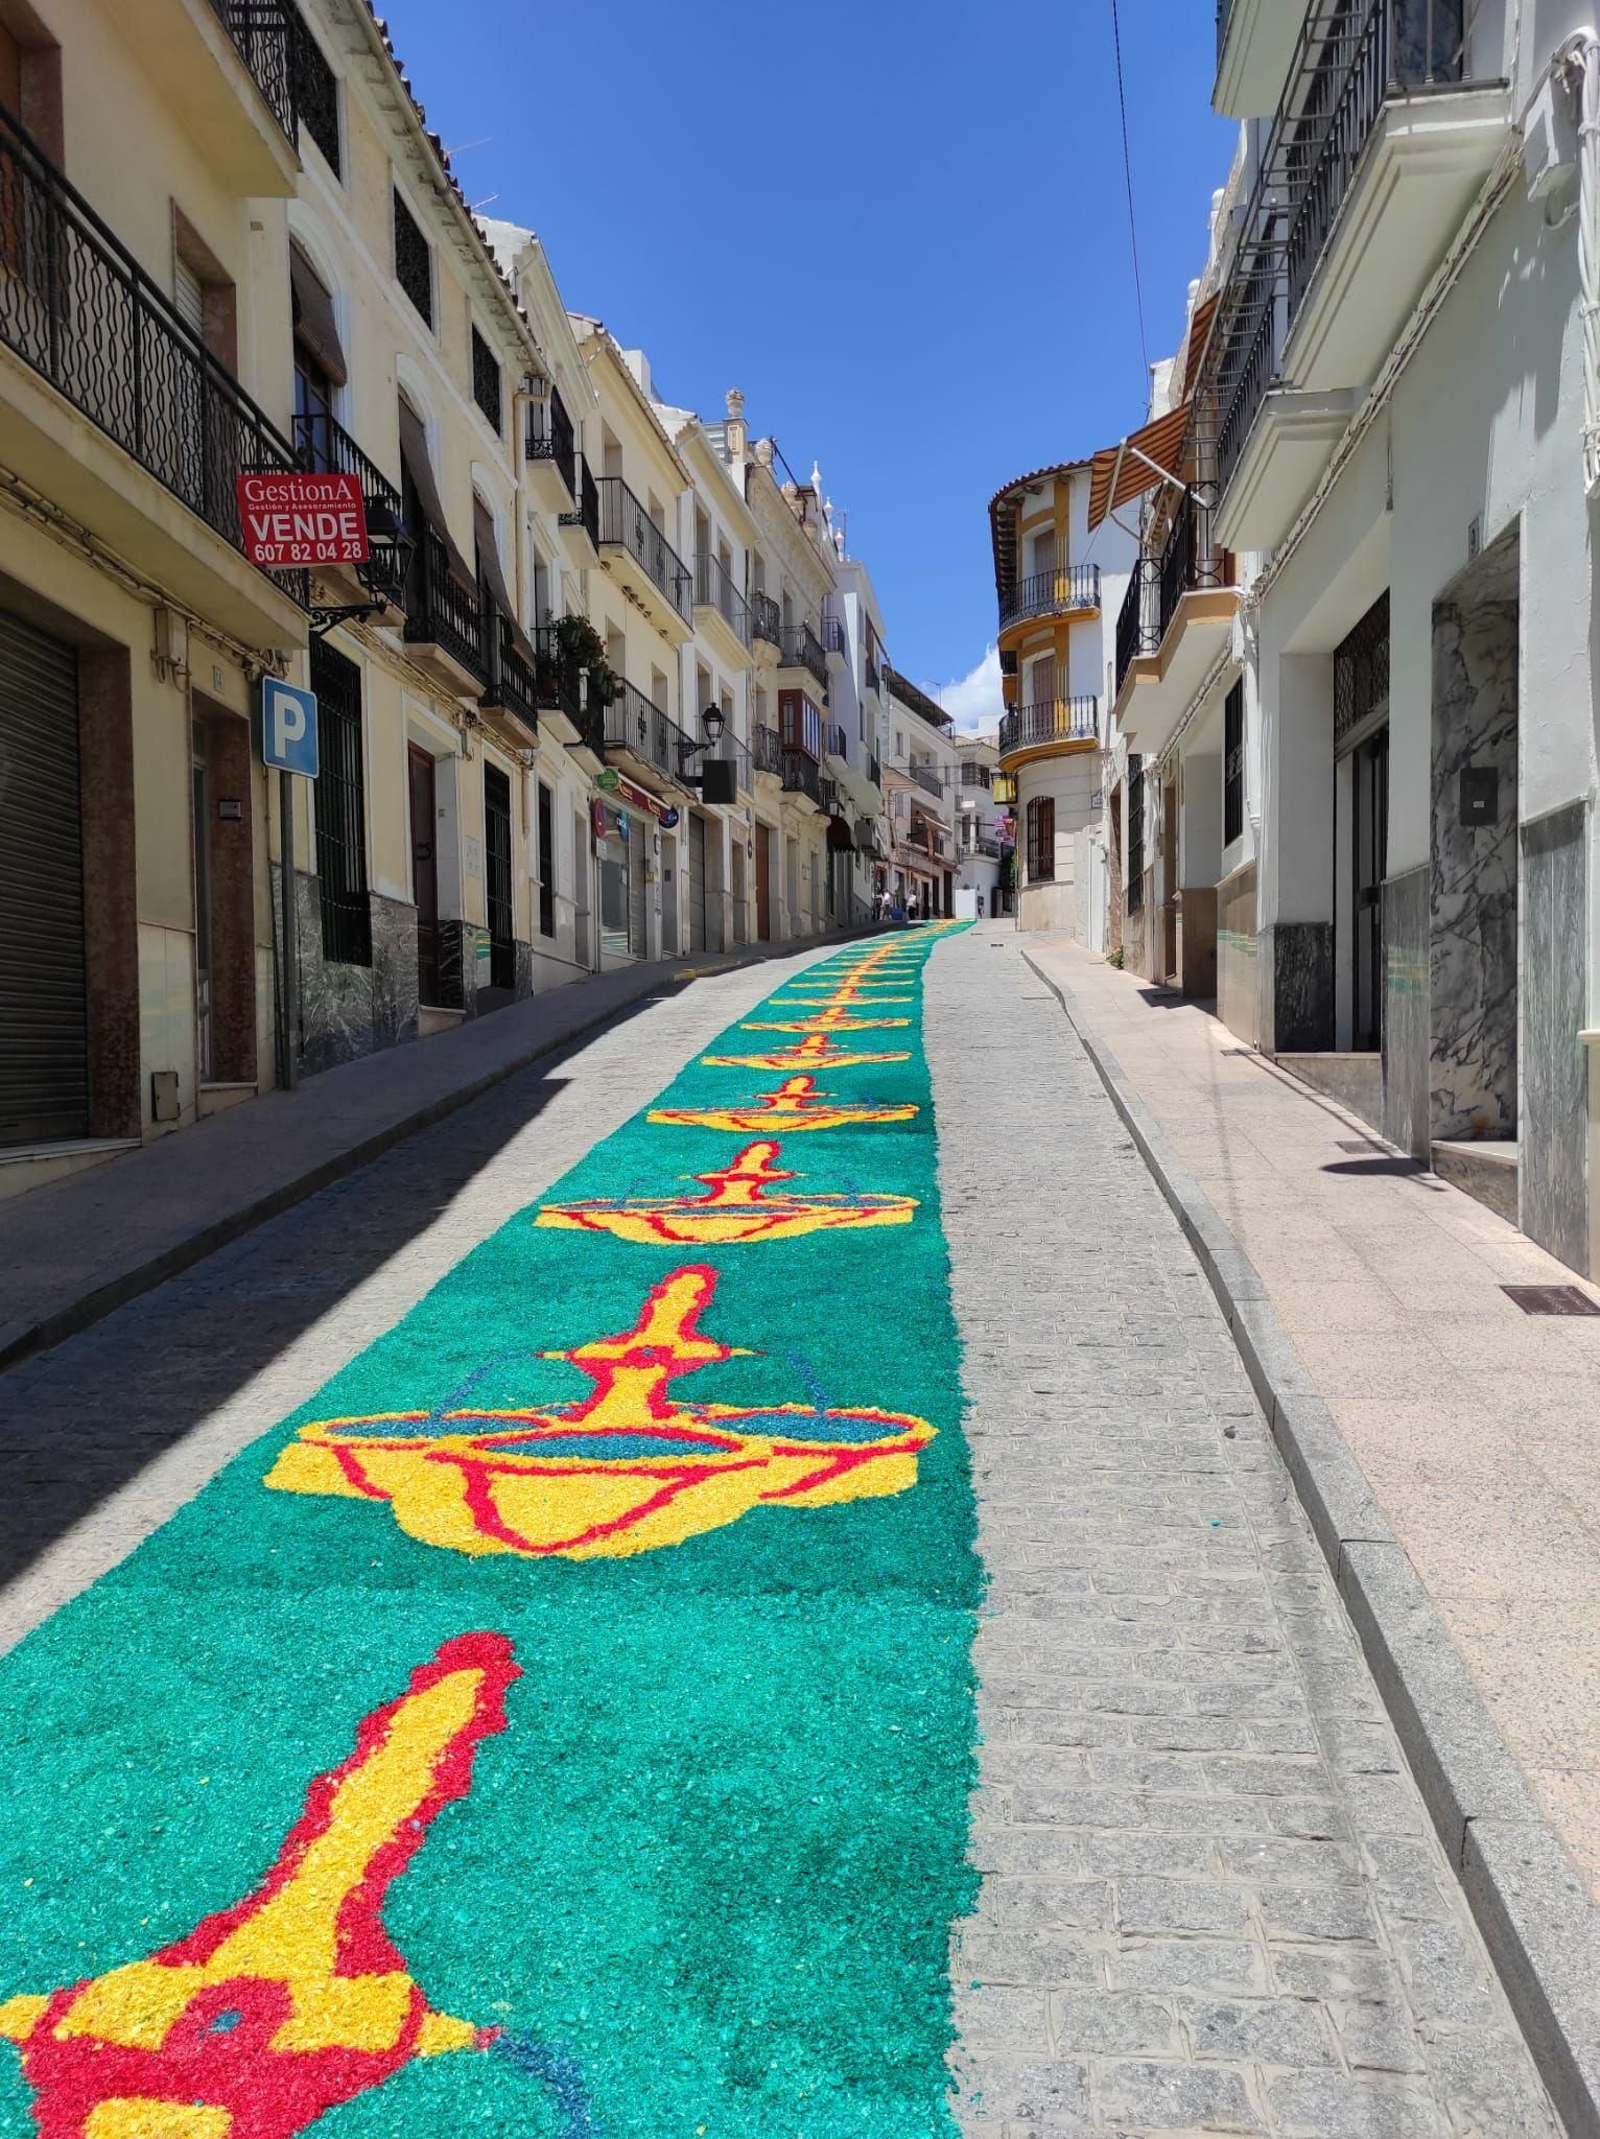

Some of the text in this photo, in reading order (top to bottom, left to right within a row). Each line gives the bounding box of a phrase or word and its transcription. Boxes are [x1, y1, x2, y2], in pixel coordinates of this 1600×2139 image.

[245, 479, 354, 502] GestionA
[291, 502, 357, 511] Asesoramiento
[248, 512, 360, 542] VENDE
[254, 541, 362, 562] 607 82 04 28
[274, 690, 306, 759] P
